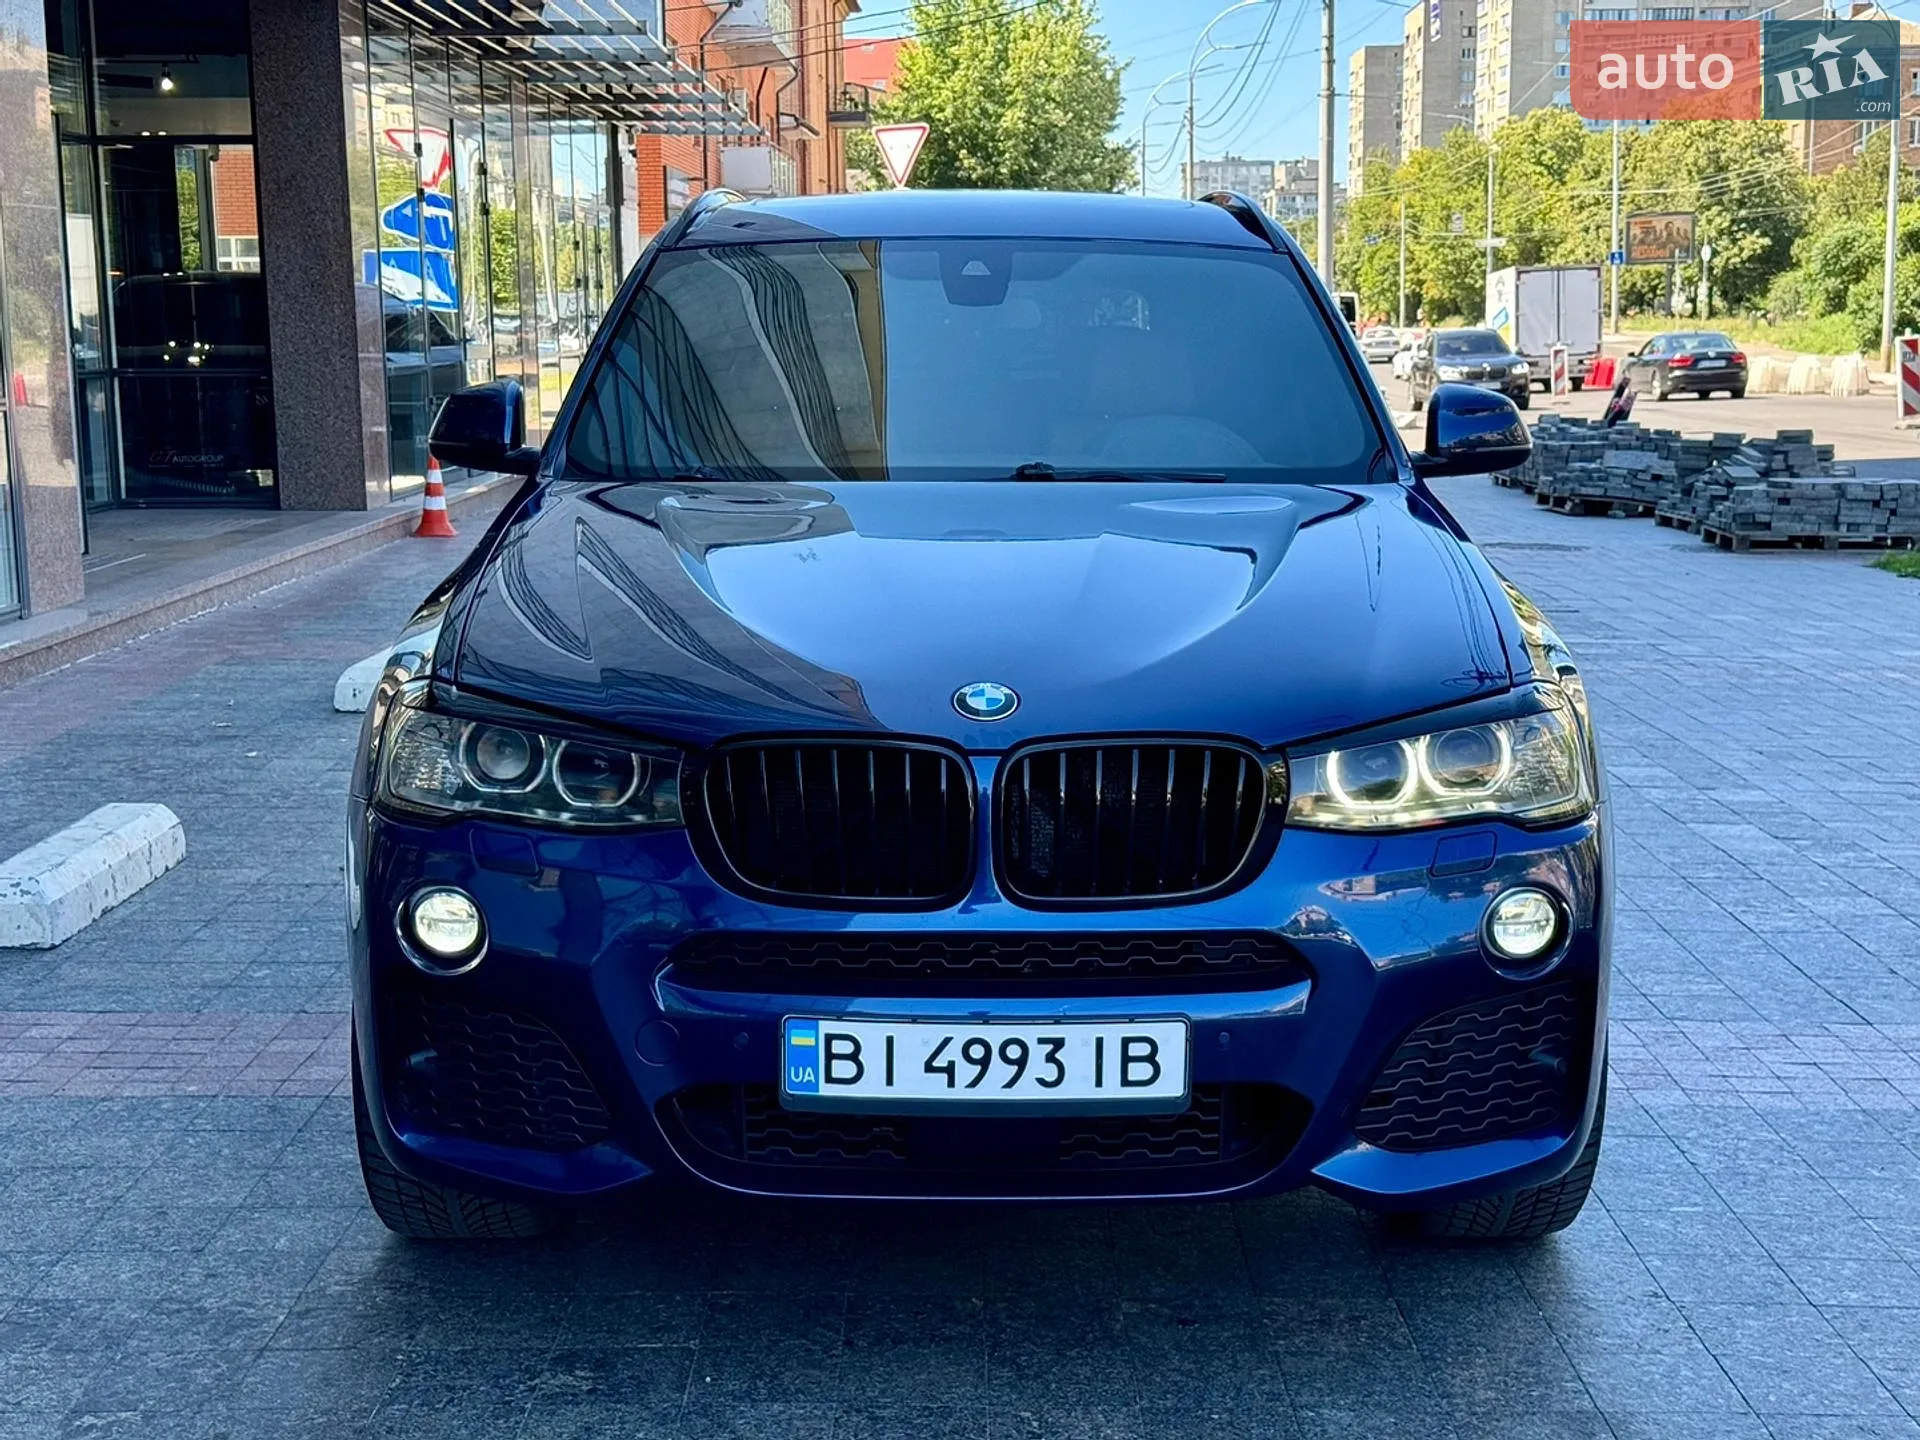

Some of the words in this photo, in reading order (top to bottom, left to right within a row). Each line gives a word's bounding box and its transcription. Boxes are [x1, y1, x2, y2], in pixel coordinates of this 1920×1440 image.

[791, 1066, 816, 1084] UA
[823, 1032, 895, 1087] BI
[923, 1036, 1066, 1089] 4993
[1094, 1036, 1162, 1089] IB
